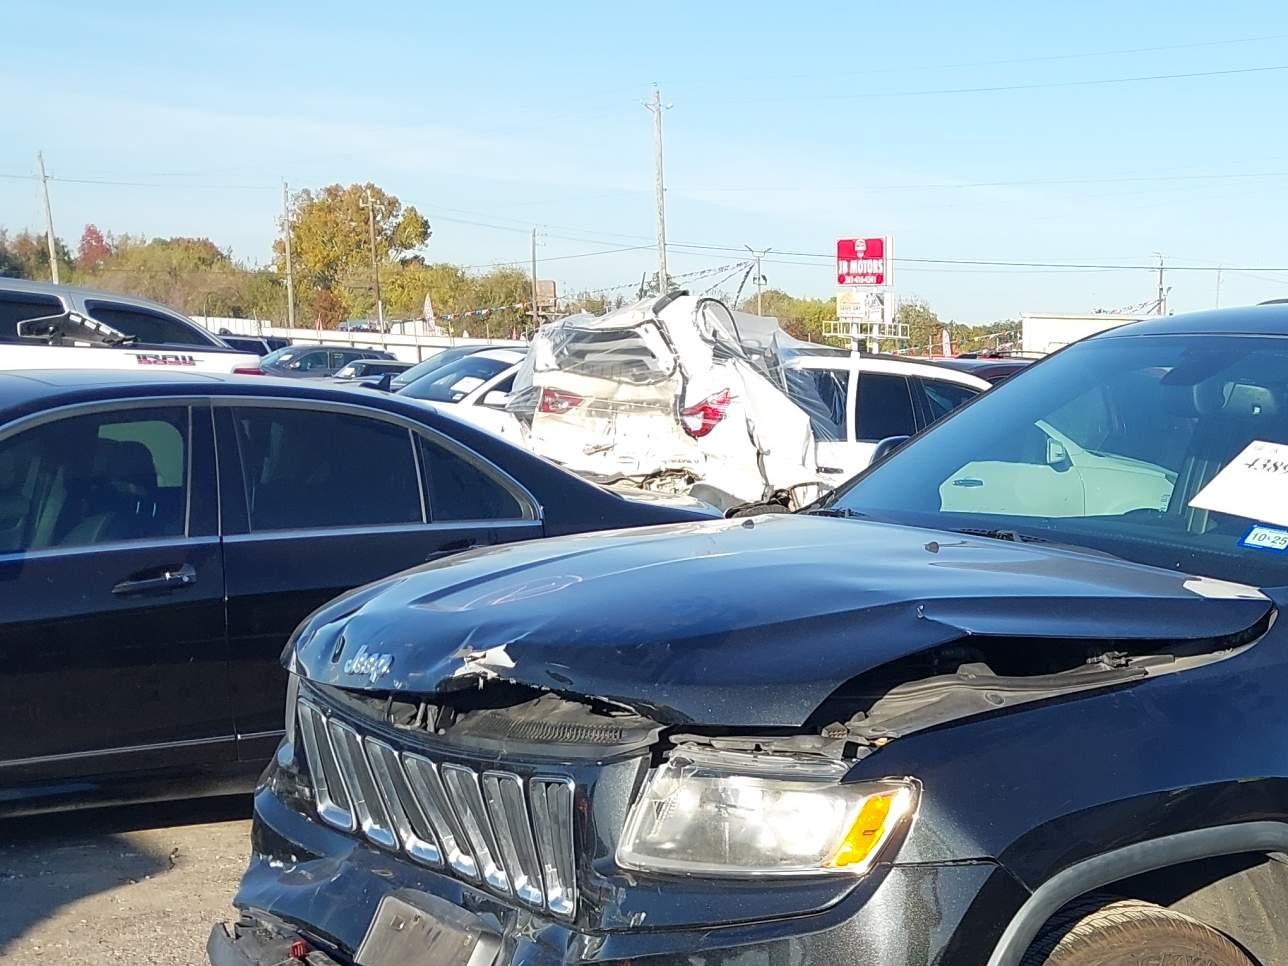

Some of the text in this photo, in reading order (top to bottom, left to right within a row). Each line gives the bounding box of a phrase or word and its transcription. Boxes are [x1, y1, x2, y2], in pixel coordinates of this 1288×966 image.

[850, 259, 884, 274] MOTORS
[1251, 532, 1288, 547] 10 25
